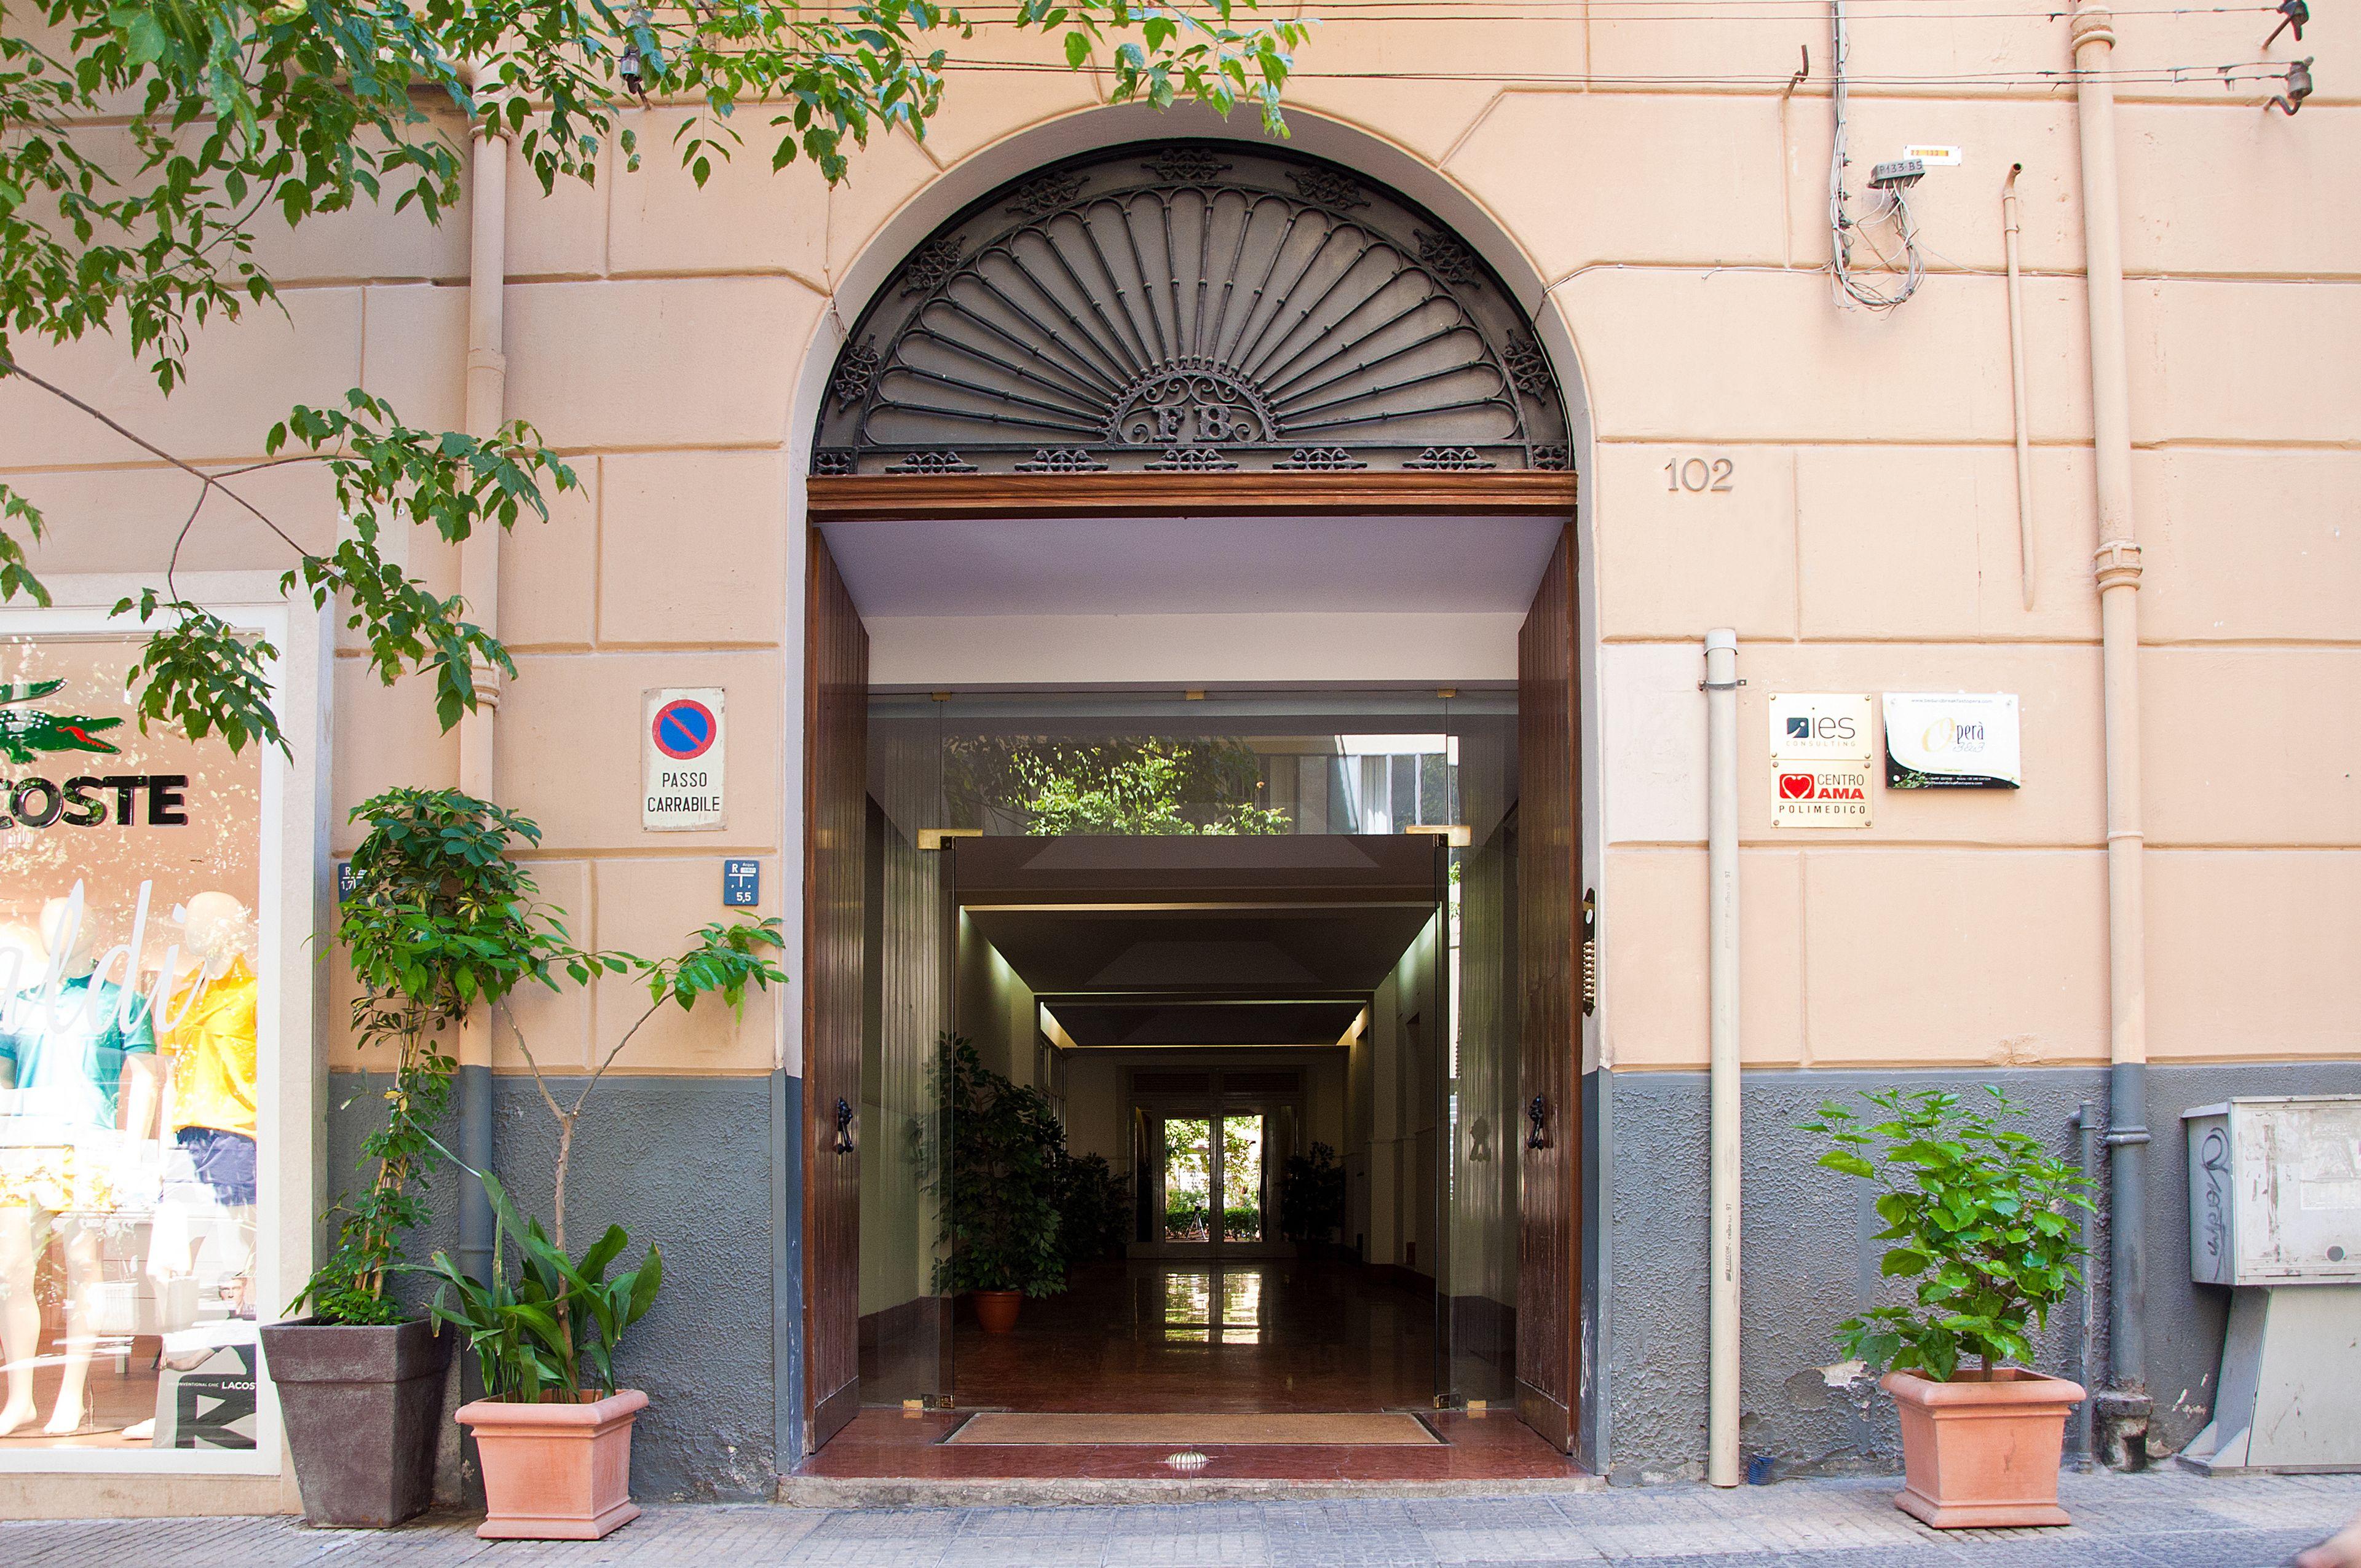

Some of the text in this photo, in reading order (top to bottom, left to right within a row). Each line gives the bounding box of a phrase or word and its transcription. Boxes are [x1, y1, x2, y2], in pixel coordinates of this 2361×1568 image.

[1664, 457, 1734, 492] 102
[1811, 707, 1856, 739] ies
[662, 772, 708, 788] PASSO
[1817, 774, 1865, 786] CENTRO
[1817, 788, 1865, 800] AMA
[647, 796, 720, 812] CARRABILE
[1779, 805, 1865, 814] POLIMEDICO
[345, 866, 351, 876] R
[732, 863, 738, 873] R
[736, 892, 751, 903] 5,5
[221, 1381, 256, 1390] LACOS
